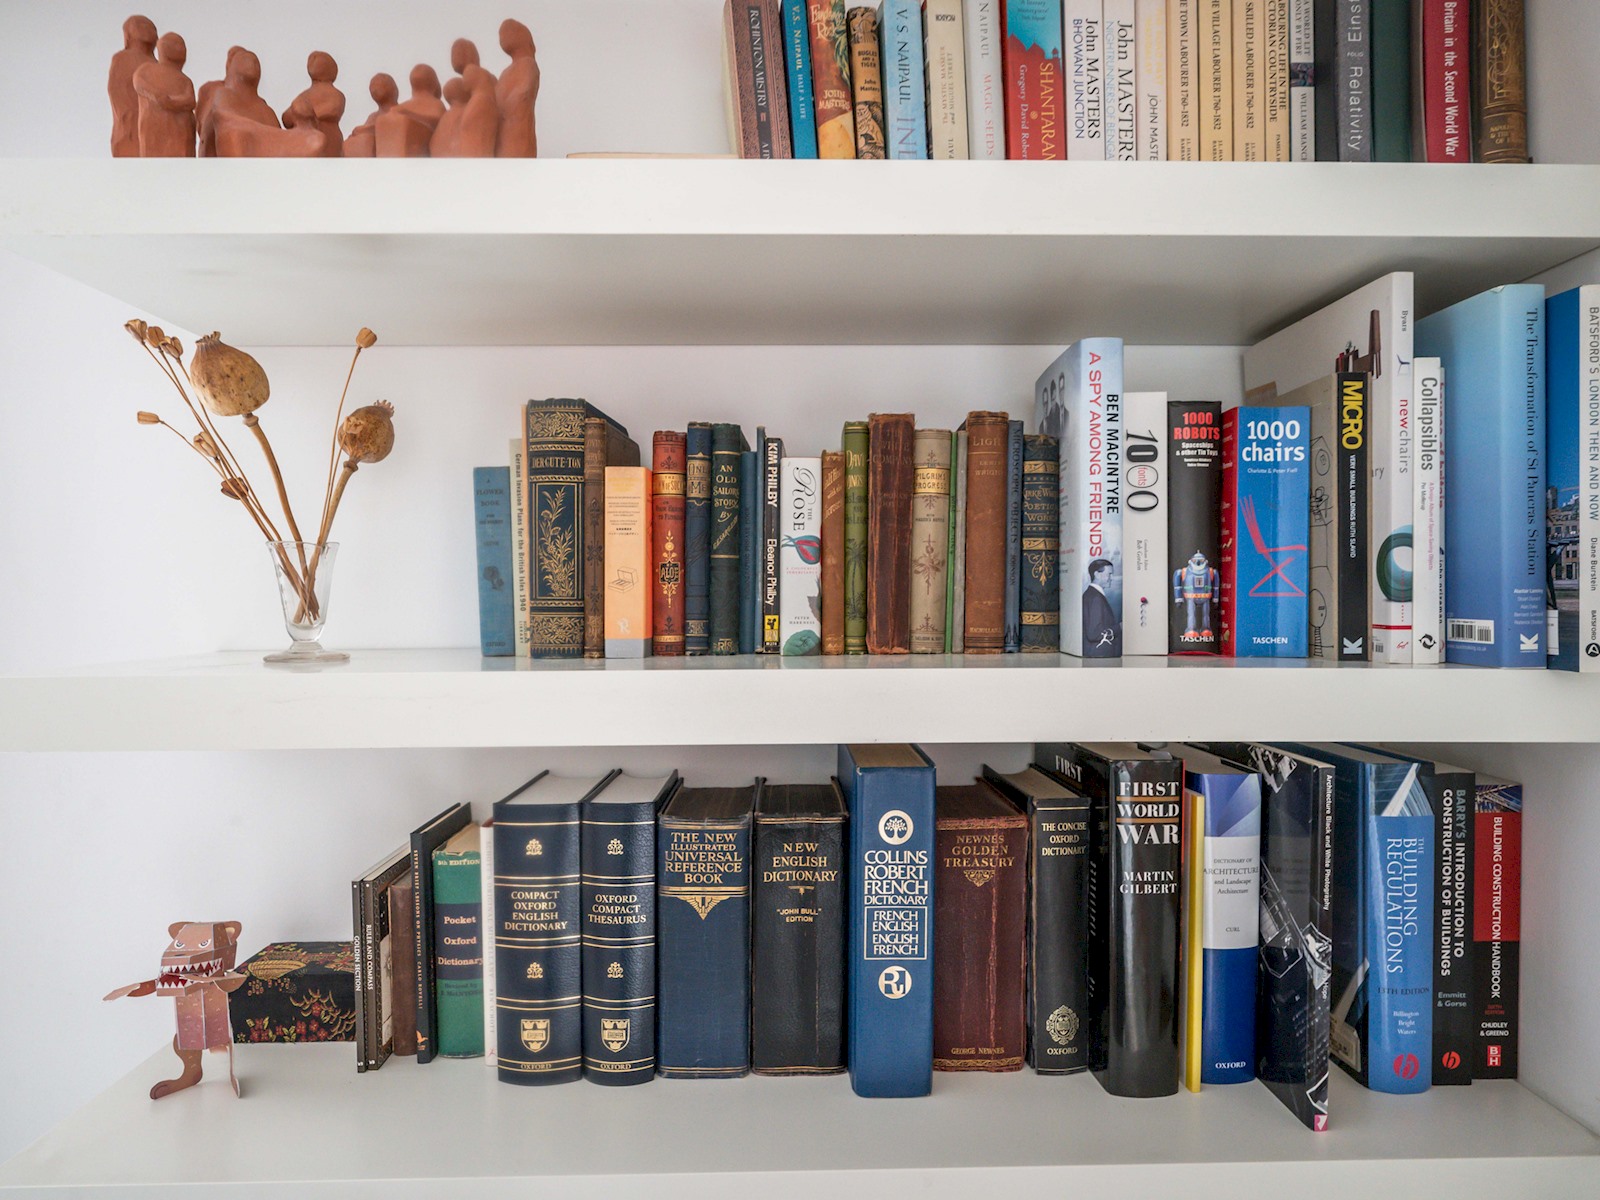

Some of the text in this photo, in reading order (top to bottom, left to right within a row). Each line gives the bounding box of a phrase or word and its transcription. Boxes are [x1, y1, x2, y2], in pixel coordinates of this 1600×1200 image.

[1245, 3, 1253, 39] SKILLED
[979, 2, 989, 59] NAIPAUL
[1117, 21, 1133, 60] John
[1180, 11, 1188, 87] TOWN LABOURER
[1212, 11, 1221, 92] VILLAGE LABOURER
[750, 10, 767, 107] ROHINTON MISTRY
[897, 9, 911, 105] V. S. NAIPAUL
[1073, 19, 1084, 139] BHOWANI JUNCTION
[1086, 19, 1100, 139] John MASTERS
[1444, 2, 1459, 156] Britain in the Second World War
[1018, 65, 1029, 129] Gregory David
[1347, 66, 1363, 150] Relativity
[1590, 307, 1600, 374] BATSFORD'S
[1590, 380, 1599, 426] LONDON
[1183, 412, 1212, 424] 1000
[1342, 381, 1363, 450] MICRO
[1247, 420, 1300, 440] 1000
[1418, 377, 1437, 470] Collapsibles
[1174, 427, 1219, 440] ROBOTS
[1527, 308, 1538, 575] The Transformation of St Pancras Station
[1590, 432, 1599, 461] THEN
[1089, 352, 1101, 556] A SPY AMONG FRIENDS
[1107, 394, 1119, 514] BEN MACINTYRE
[1242, 442, 1305, 461] chairs
[1138, 467, 1148, 486] fonts
[1589, 466, 1599, 489] AND
[1590, 495, 1599, 520] NOW
[765, 443, 778, 606] KIM PHILBY Eleanor Philby
[1056, 755, 1082, 781] FIRST
[1119, 781, 1180, 796] FIRST
[1118, 804, 1179, 817] WORLD
[1042, 822, 1086, 831] THE CONCISE
[671, 833, 737, 842] THE NEW
[956, 835, 1004, 844] NEWNES
[1050, 834, 1079, 843] OXFORD
[1117, 825, 1180, 844] WAR
[784, 843, 818, 852] NEW
[952, 846, 1008, 855] GOLDEN
[1042, 846, 1086, 856] DICTIONARY
[666, 851, 742, 862] UNIVERSAL
[773, 857, 826, 867] ENGLISH
[865, 851, 927, 864] COLLINS
[944, 857, 1014, 867] TREASURY
[666, 862, 741, 872] REFERENCE
[865, 866, 926, 880] ROBERT
[1203, 867, 1259, 875] ARCHITECTURE
[1454, 789, 1466, 957] BARRY'S INTRODUCTION TO
[685, 874, 723, 883] BOOK
[764, 871, 837, 882] DICTIONARY
[1123, 871, 1174, 881] MARTIN
[1441, 789, 1452, 976] CONSTRUCTION OF BUILDINGS
[865, 881, 927, 894] FRENCH
[1120, 884, 1177, 894] GILBERT
[1323, 869, 1331, 910] Photography
[1403, 838, 1417, 935] BUILDING
[596, 895, 637, 903] OXFORD
[865, 895, 927, 905] DICTIONARY
[1386, 838, 1403, 973] REGULATIONS
[514, 902, 556, 910] OXFORD
[592, 905, 640, 913] COMPACT
[1490, 817, 1502, 999] BUILDING CONSTRUCTION HANDBOOK
[444, 916, 476, 924] Pocket
[513, 912, 558, 920] ENGLISH
[588, 915, 646, 924] THESAURUS
[874, 911, 918, 920] FRENCH
[505, 921, 568, 931] DICTIONARY
[873, 921, 918, 931] ENGLISH
[444, 937, 476, 945] Oxford
[873, 934, 918, 944] ENGLISH
[874, 945, 918, 955] FRENCH
[1401, 987, 1429, 995] EDITION
[1047, 1047, 1077, 1055] OXFORD
[1216, 1061, 1246, 1069] OXFORD
